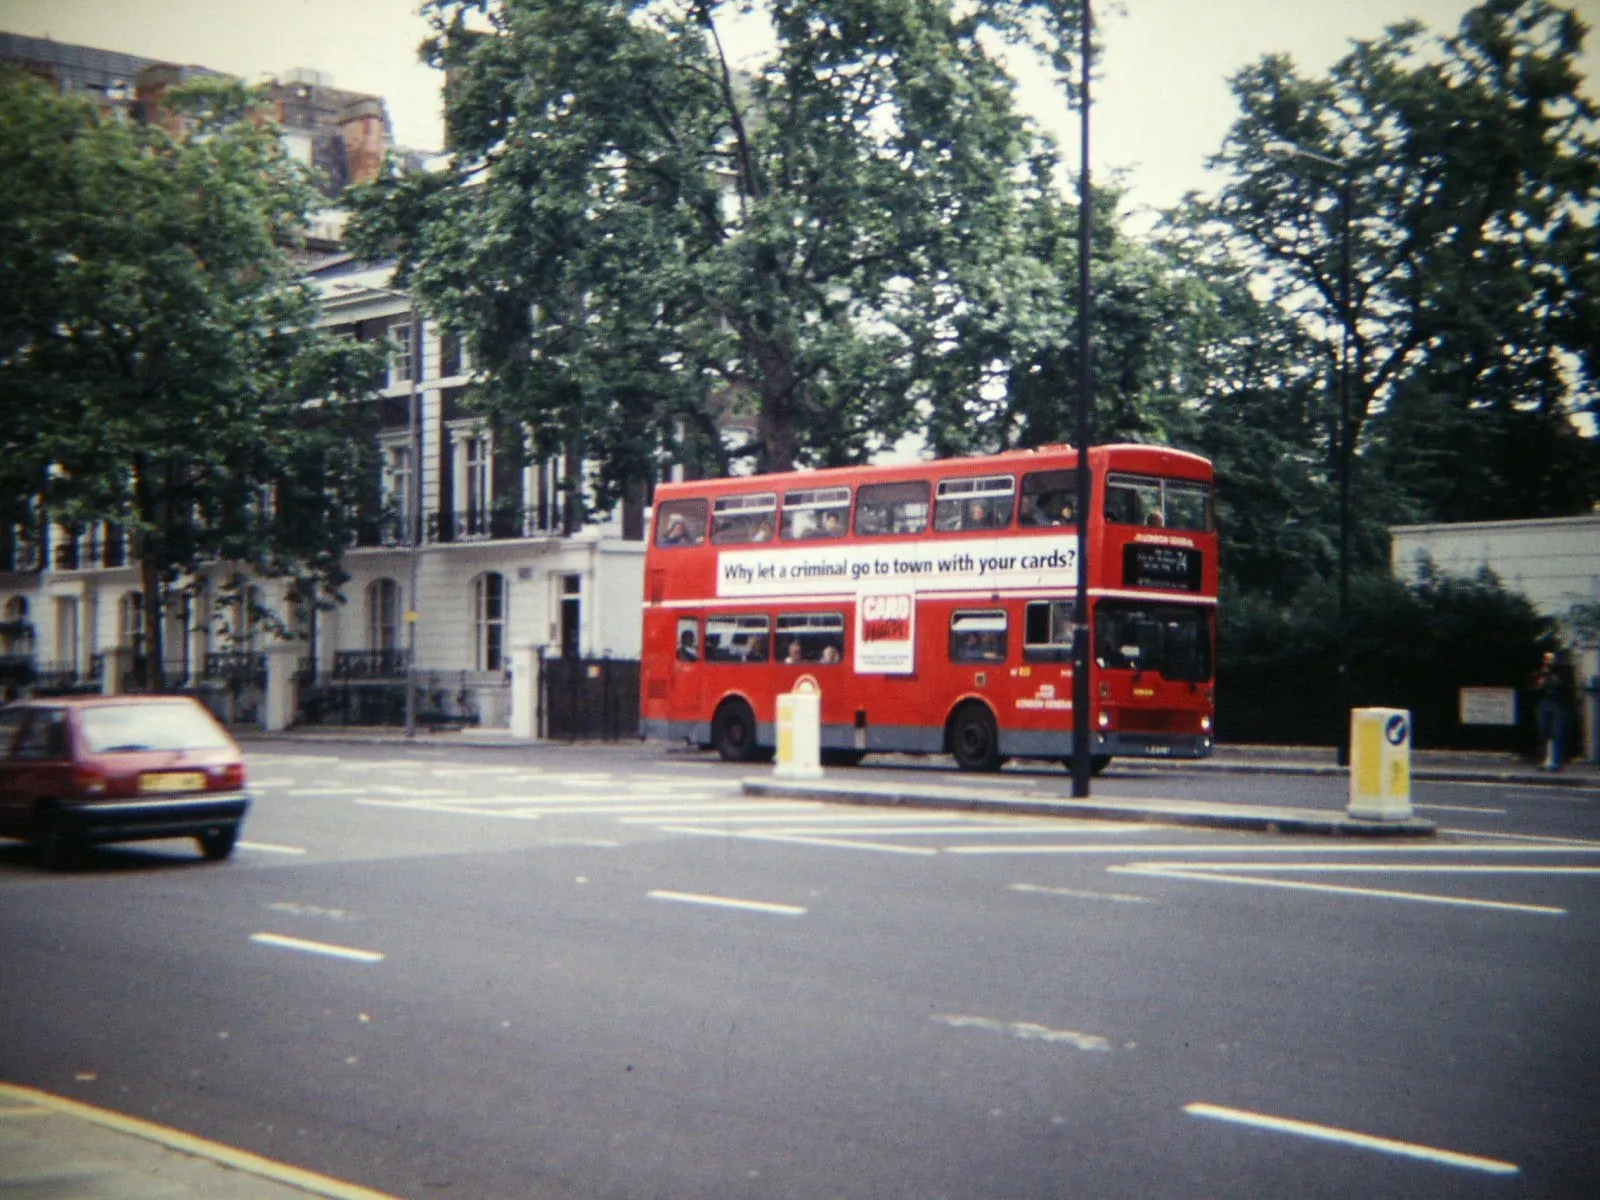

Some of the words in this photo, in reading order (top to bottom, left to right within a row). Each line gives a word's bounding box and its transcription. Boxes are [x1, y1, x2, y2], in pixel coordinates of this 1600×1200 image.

[724, 563, 754, 584] Why
[758, 562, 776, 578] let
[779, 566, 787, 578] a
[790, 558, 848, 578] criminal
[851, 562, 871, 580] go
[874, 558, 890, 574] to
[893, 558, 933, 574] town
[937, 553, 974, 572] with
[979, 555, 1017, 576] your
[1020, 548, 1076, 570] cards?
